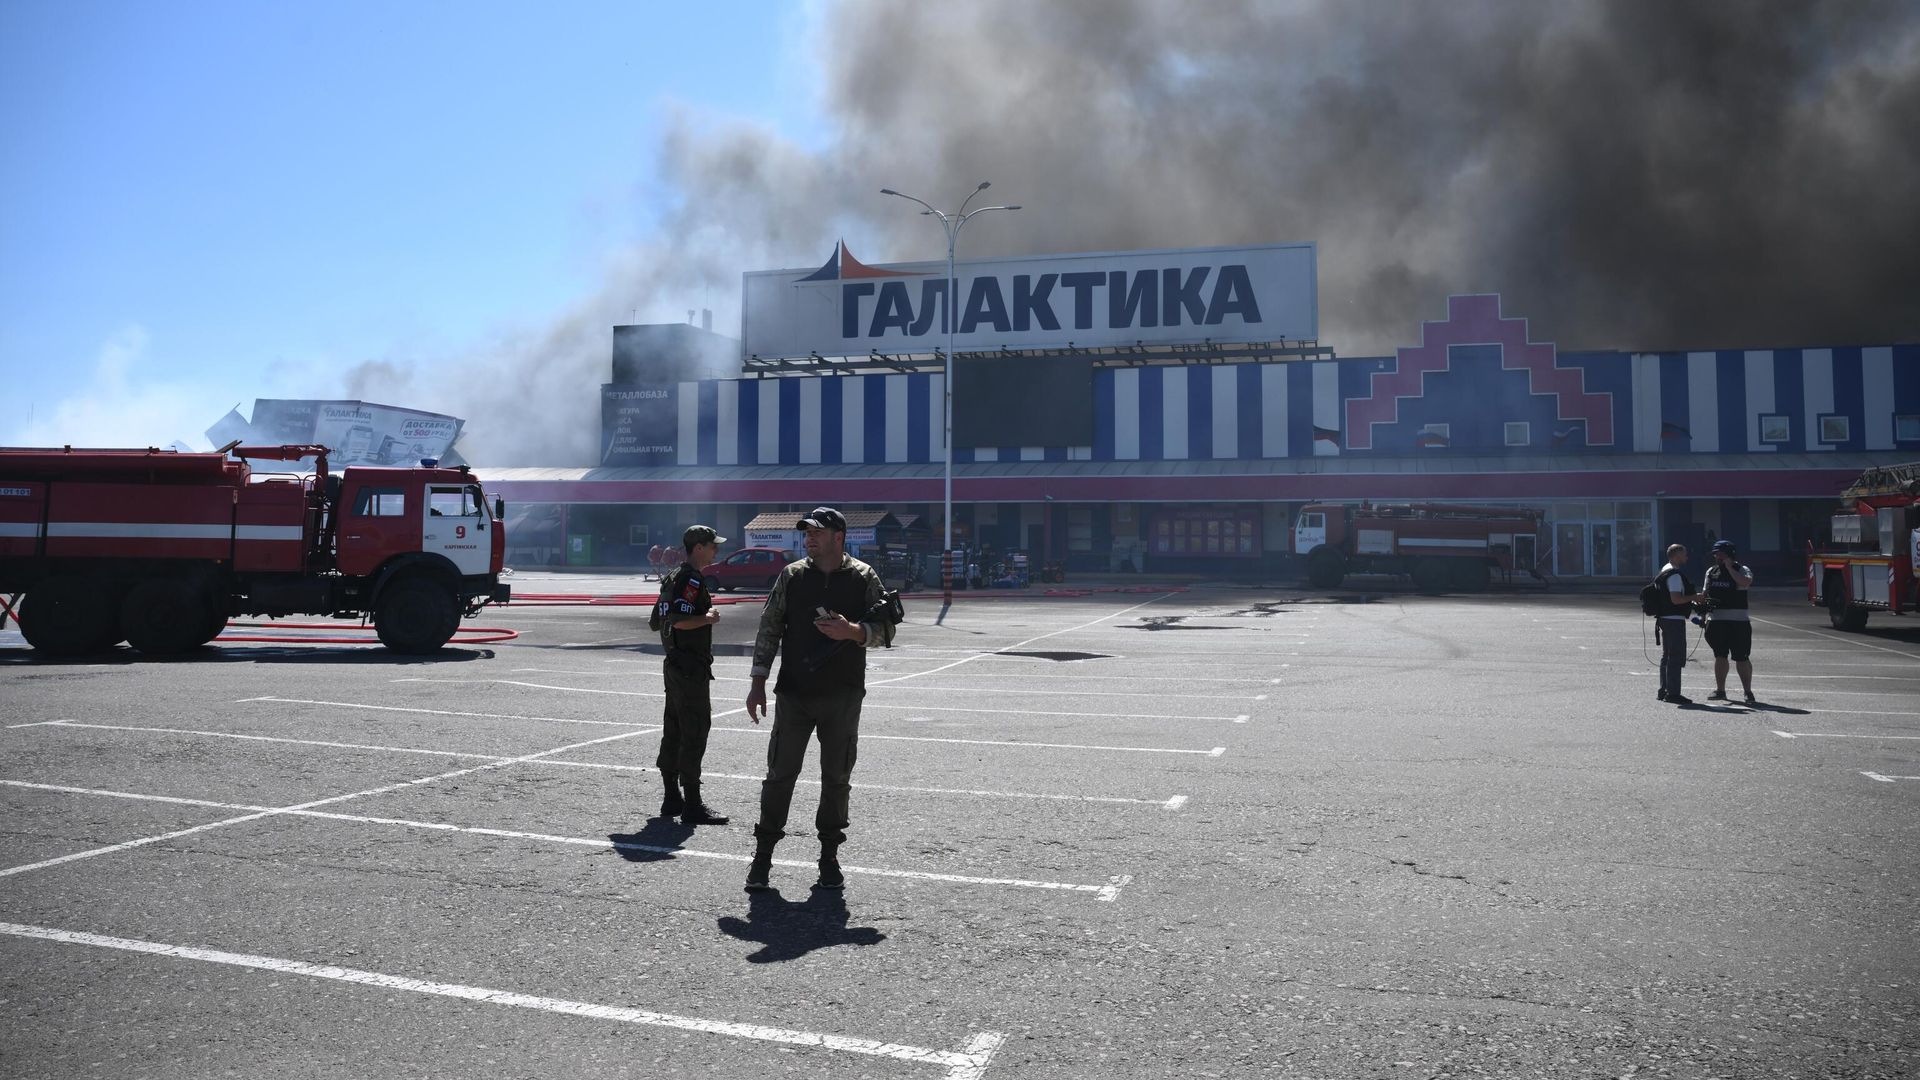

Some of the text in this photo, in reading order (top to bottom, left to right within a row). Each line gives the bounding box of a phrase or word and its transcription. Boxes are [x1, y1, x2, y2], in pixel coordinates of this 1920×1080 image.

[842, 265, 1262, 338] ГАЛАКТИКА
[405, 421, 452, 430] ДОСТАВКА
[413, 429, 431, 437] 500
[456, 525, 466, 539] 9
